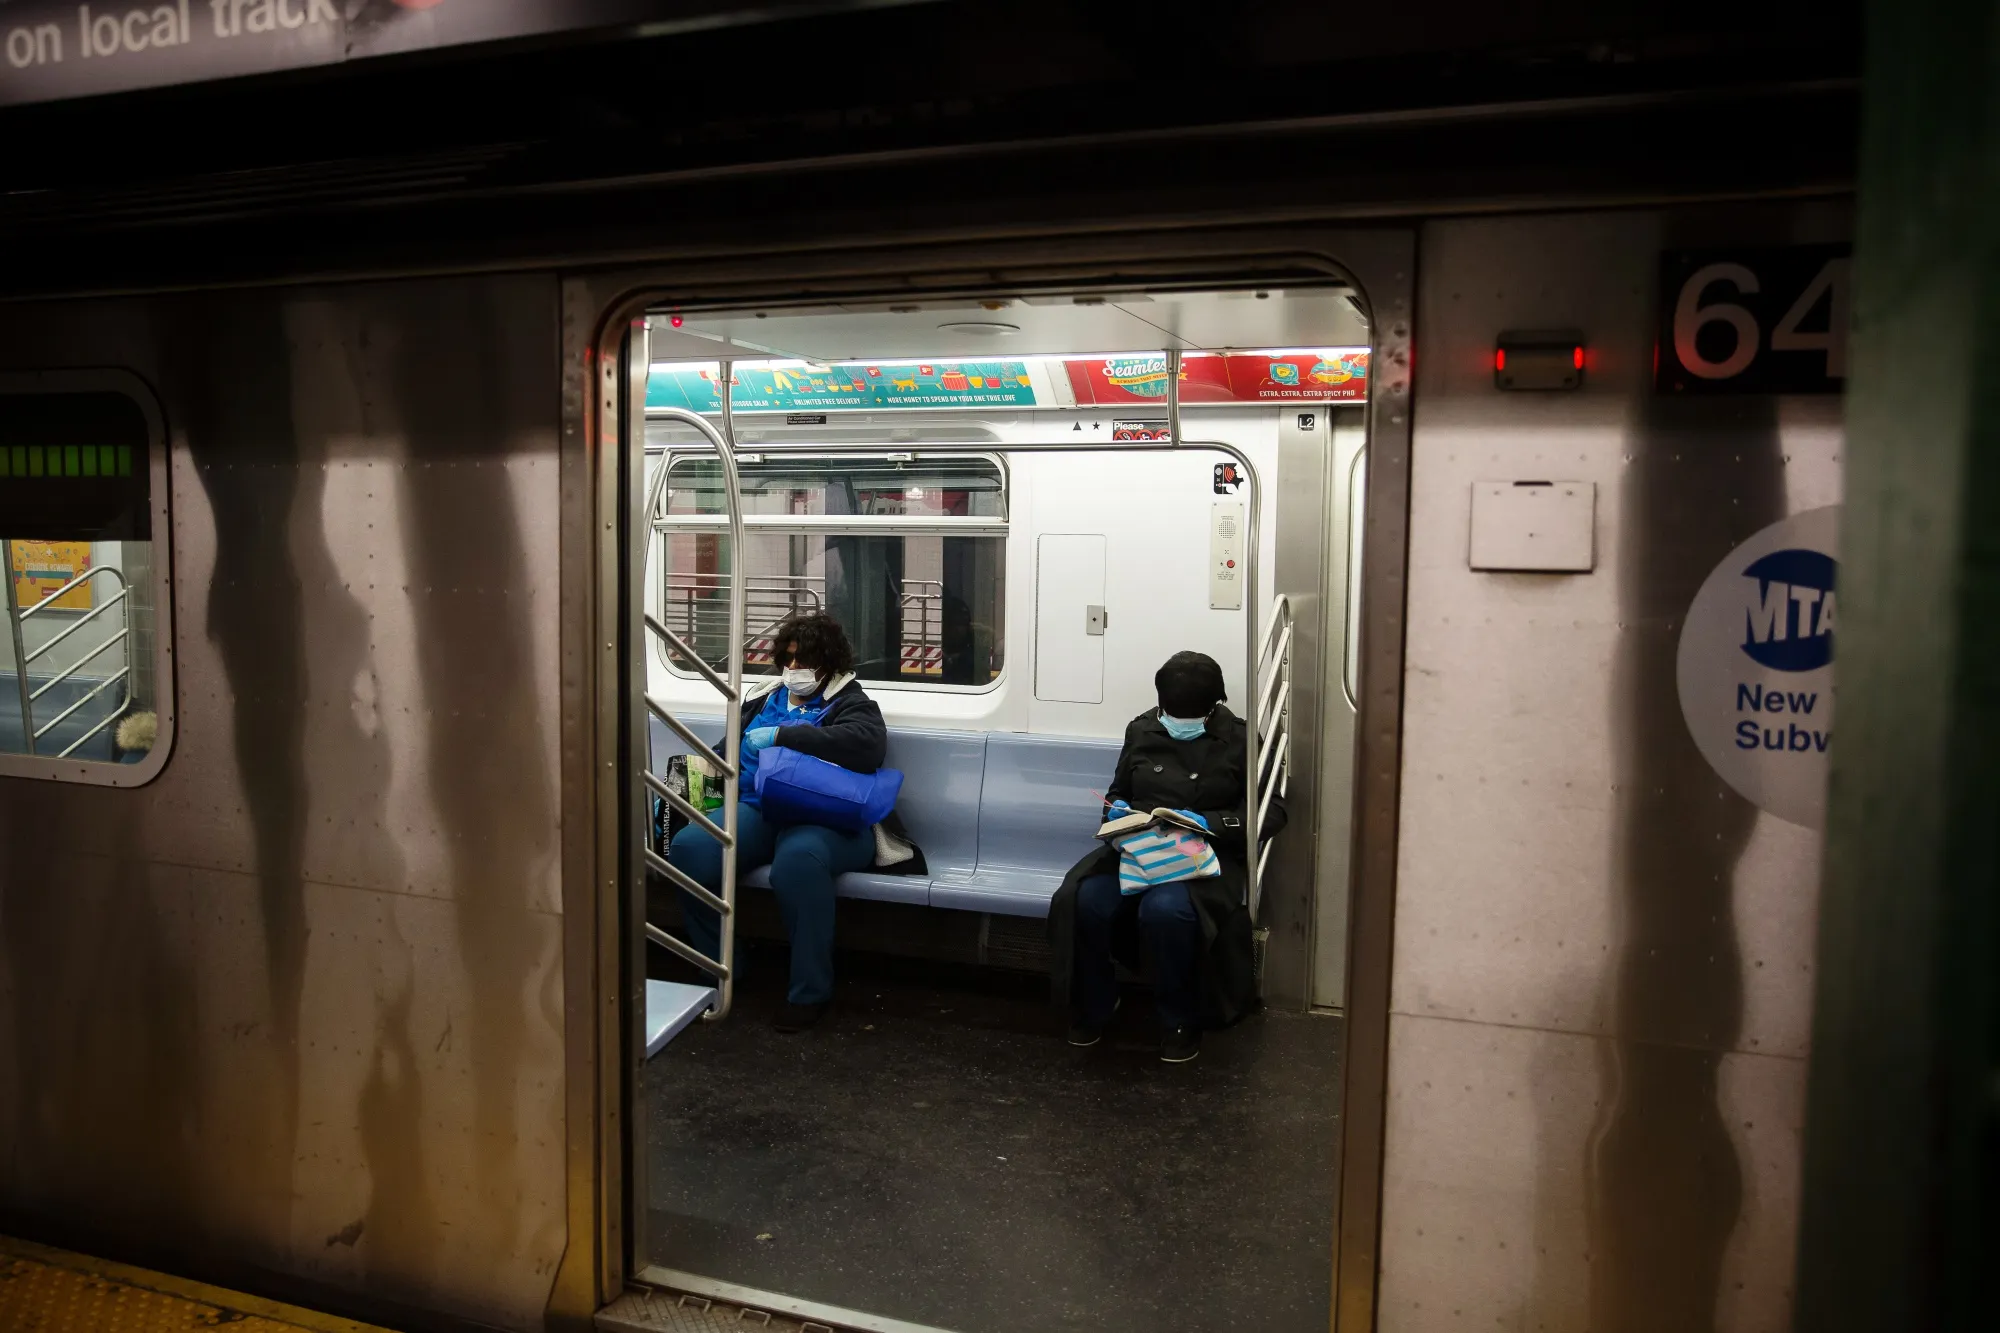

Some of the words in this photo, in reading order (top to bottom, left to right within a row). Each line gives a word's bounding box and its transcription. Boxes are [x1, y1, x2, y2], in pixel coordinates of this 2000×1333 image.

[6, 24, 63, 68] on
[78, 0, 190, 58] local
[209, 0, 339, 38] track
[1673, 257, 1849, 380] 64
[1102, 359, 1187, 377] Seamles
[836, 397, 861, 405] DELIVERY
[887, 396, 903, 404] MORE
[931, 395, 949, 403] SPEND
[949, 395, 958, 403] ON
[958, 395, 973, 403] YOUR
[986, 394, 1001, 402] TRUE
[1001, 394, 1016, 402] LOVE
[1114, 422, 1144, 431] Please
[1299, 417, 1314, 428] L2
[1745, 576, 1837, 644] MTA
[1736, 683, 1817, 714] New
